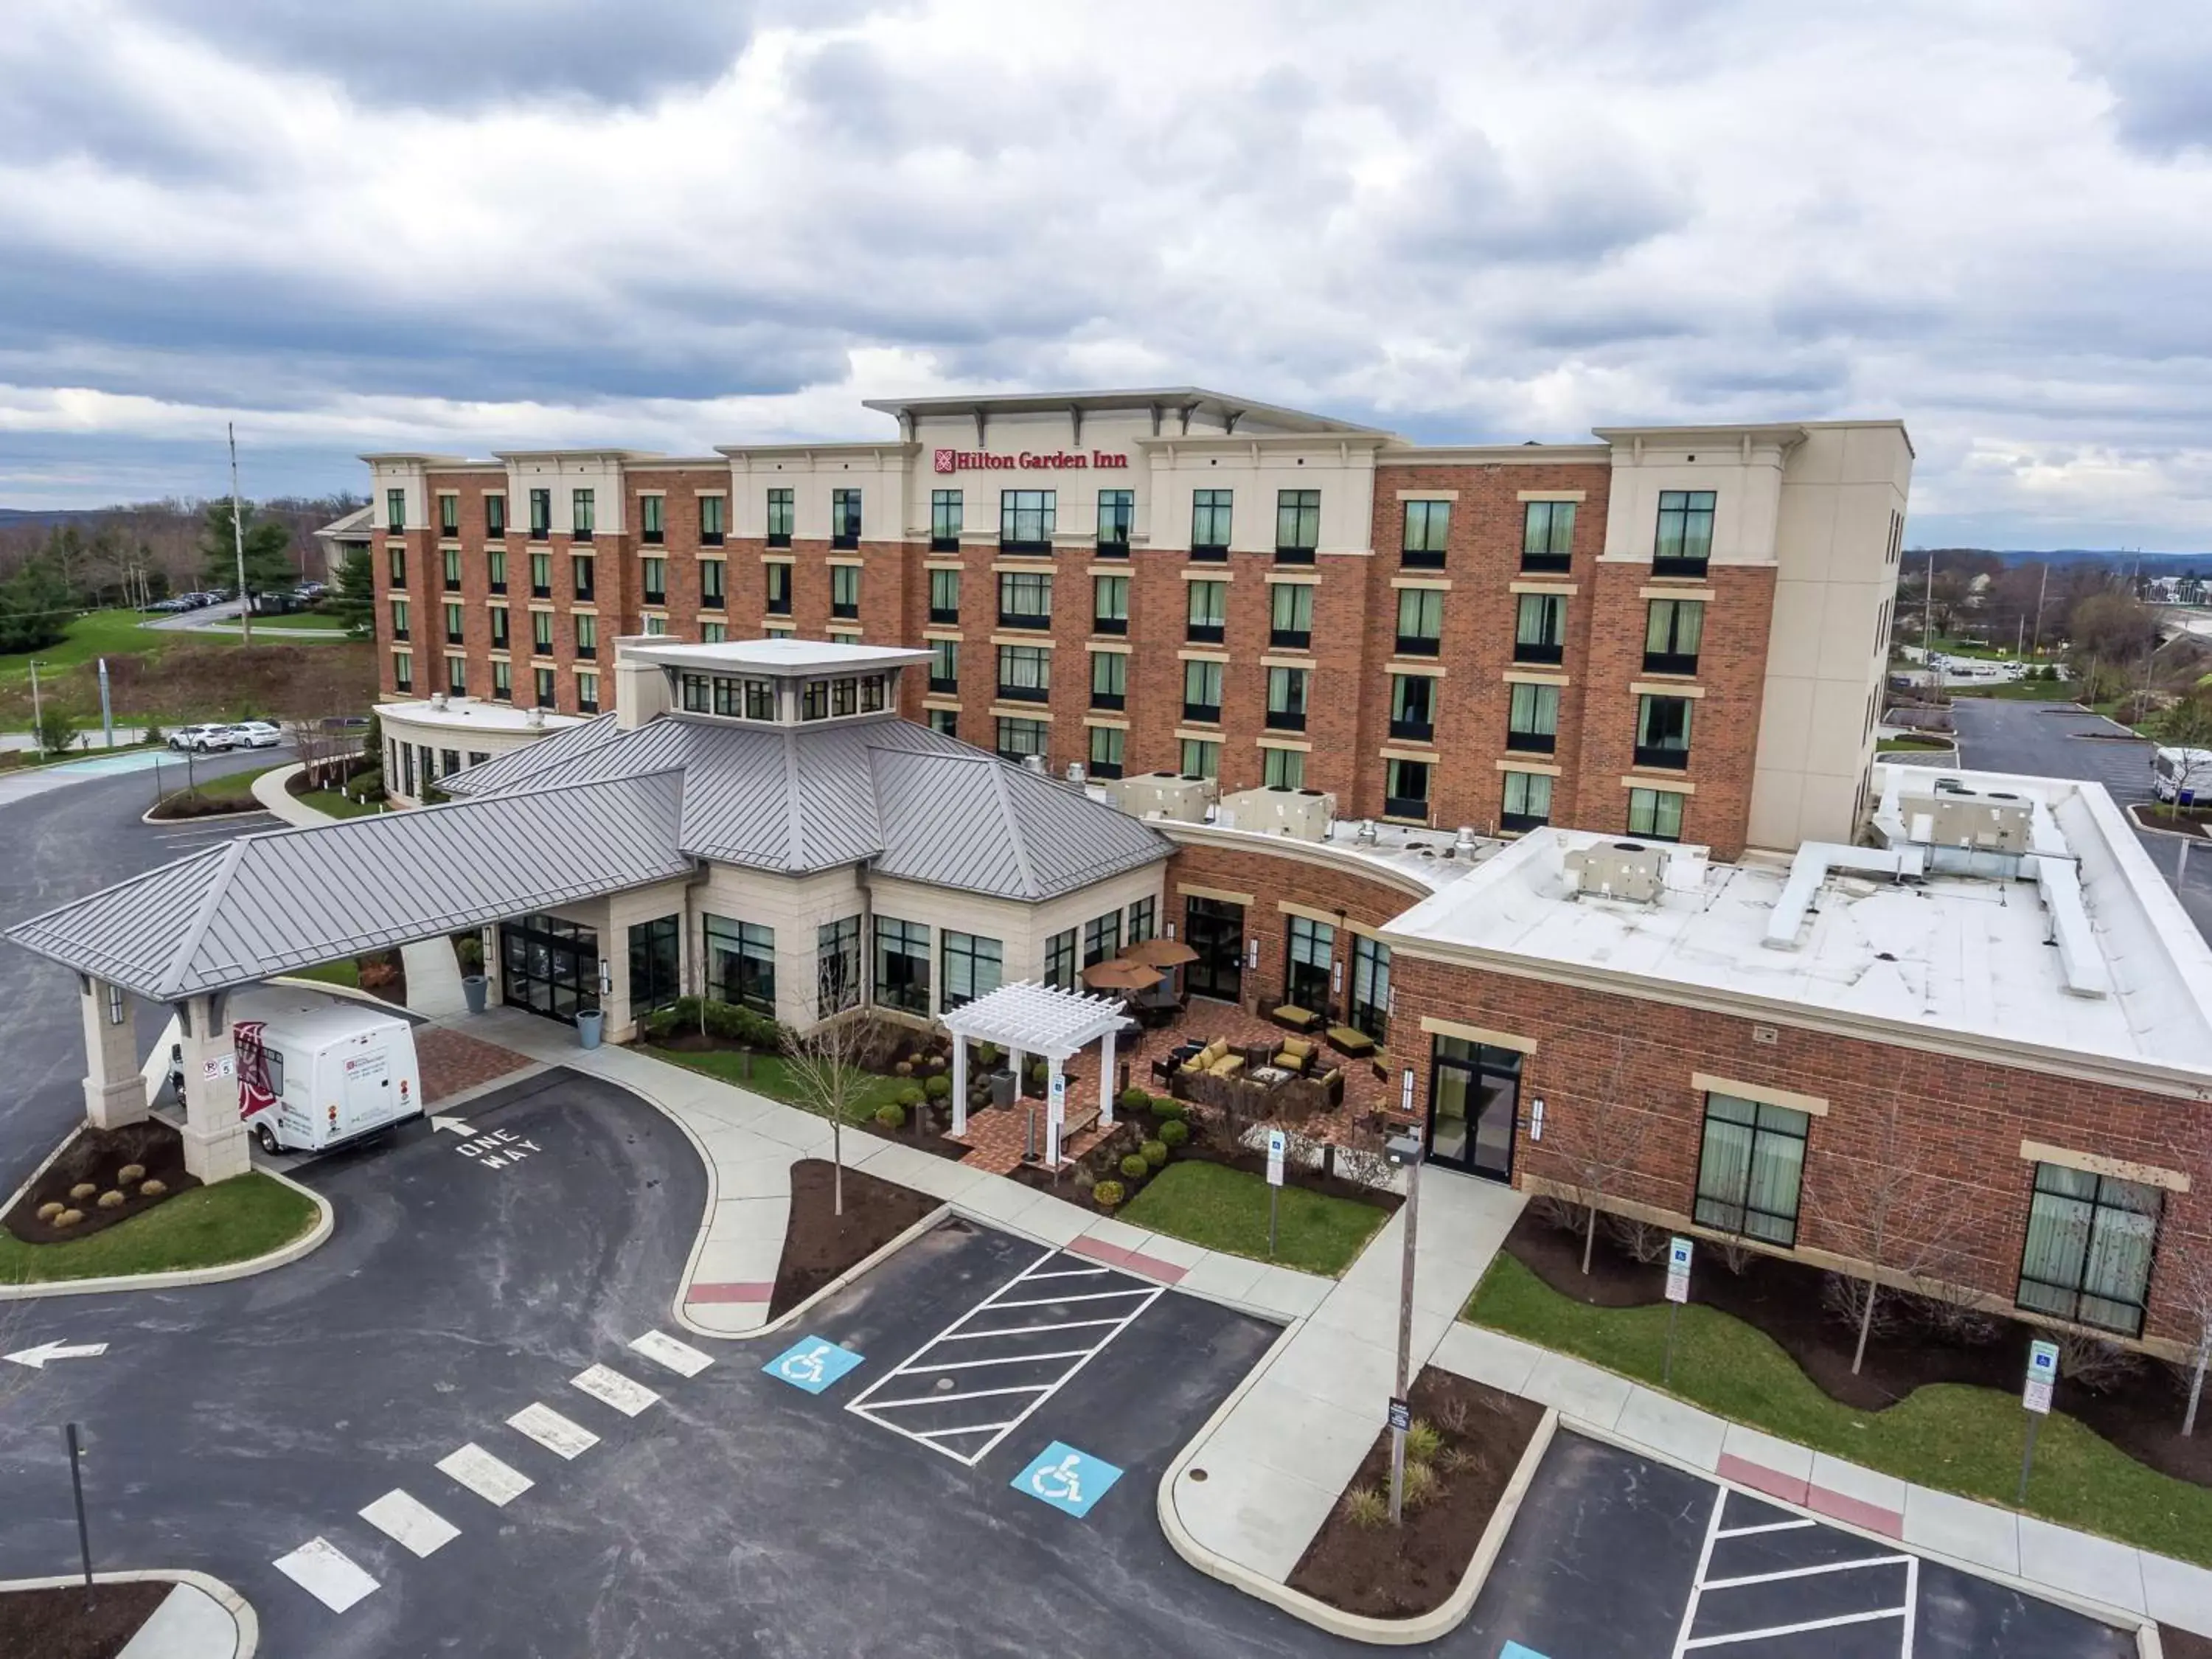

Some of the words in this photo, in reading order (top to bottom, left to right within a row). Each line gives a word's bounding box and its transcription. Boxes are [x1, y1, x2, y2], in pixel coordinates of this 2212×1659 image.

[957, 452, 1015, 470] Hilton
[1019, 451, 1087, 469] Garden
[1093, 451, 1127, 468] Inn
[455, 1128, 520, 1157] ONE
[480, 1139, 542, 1169] WAY
